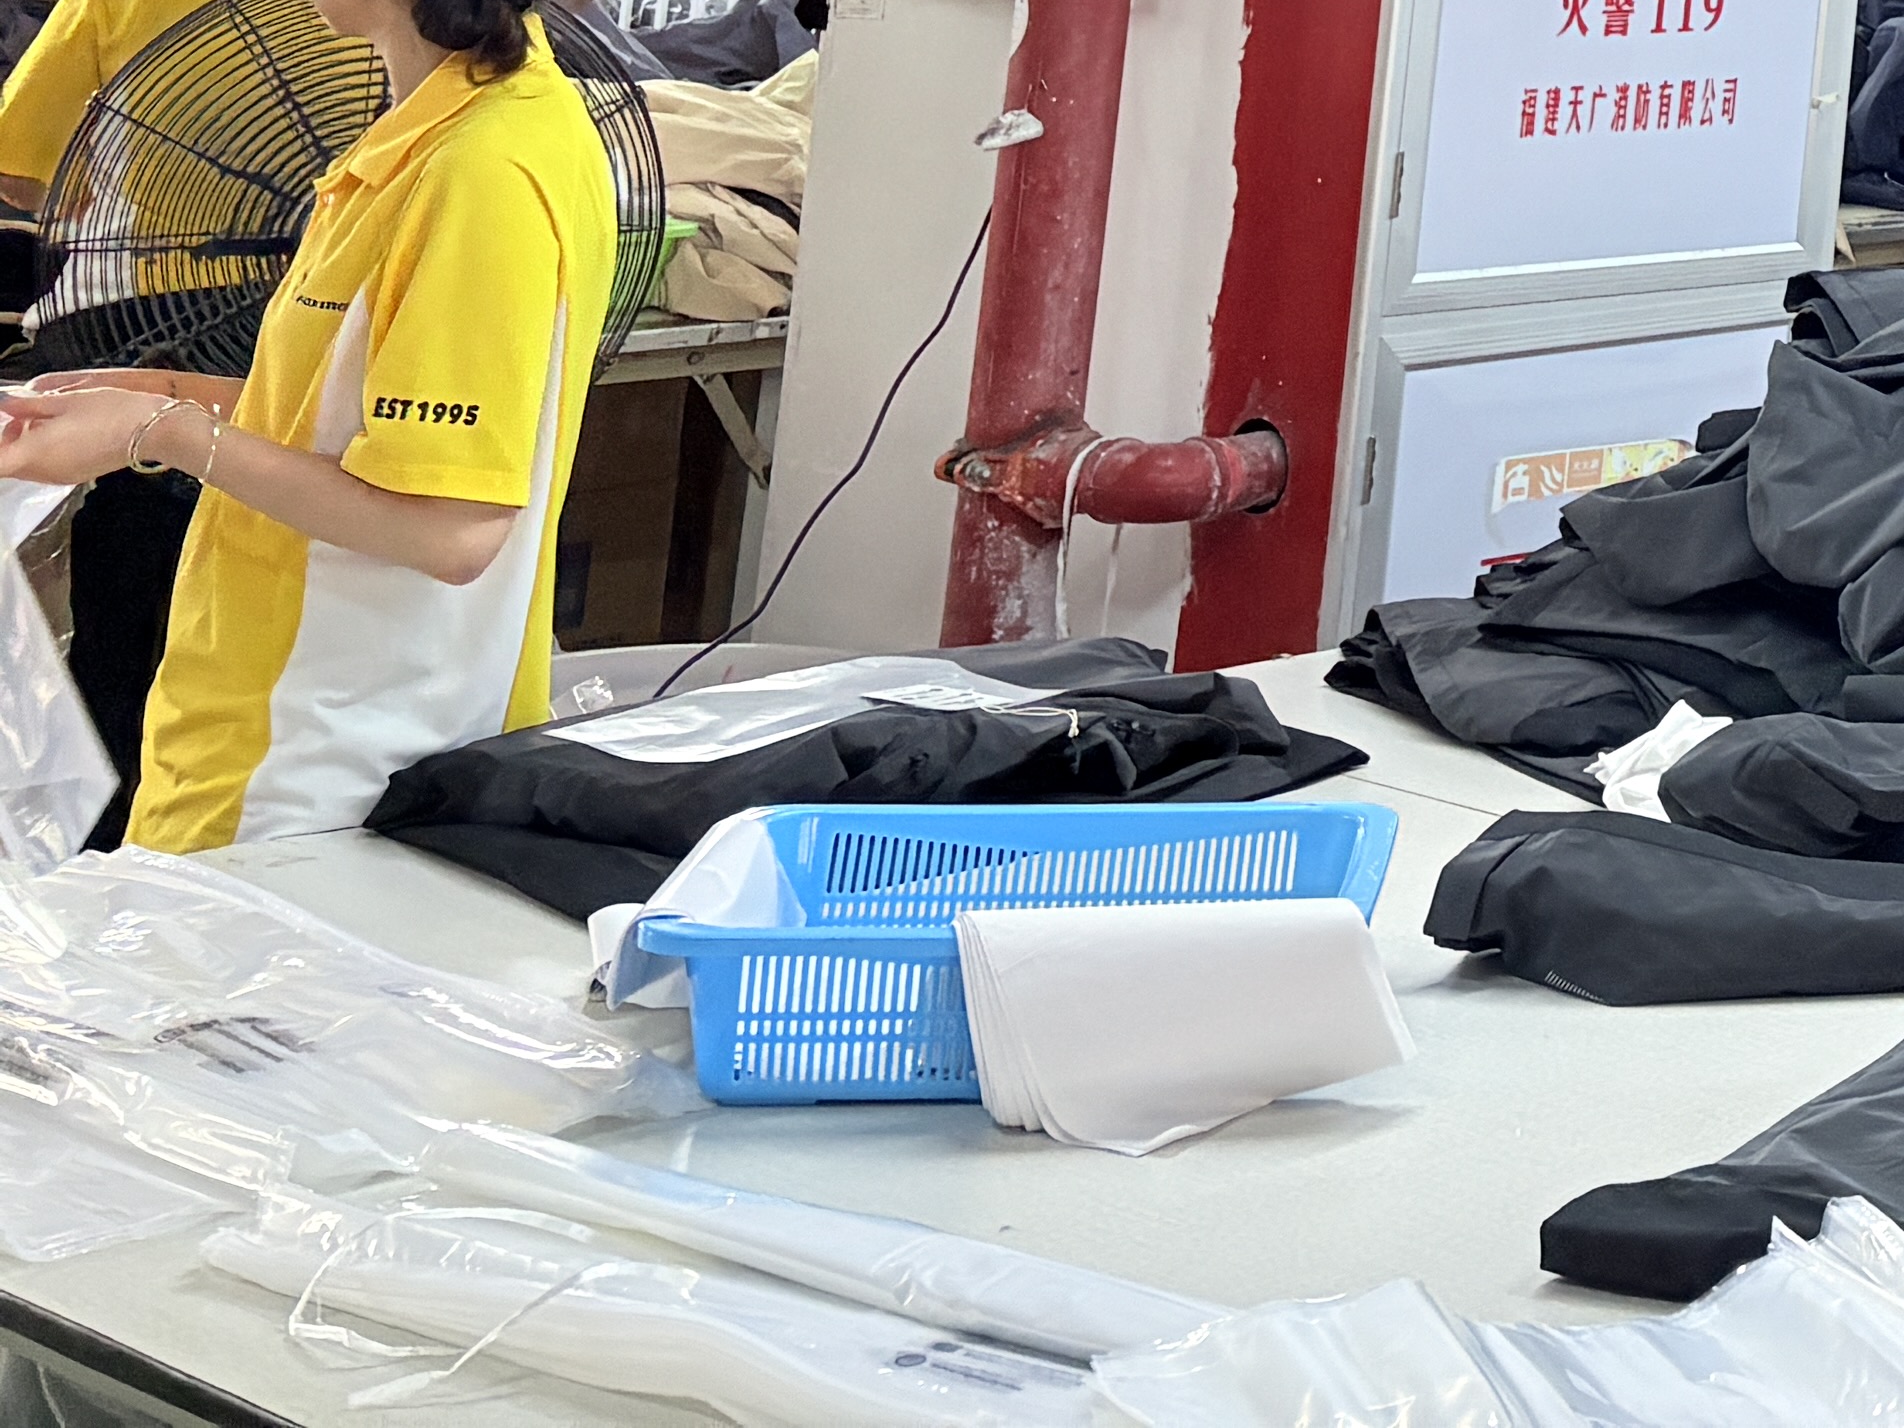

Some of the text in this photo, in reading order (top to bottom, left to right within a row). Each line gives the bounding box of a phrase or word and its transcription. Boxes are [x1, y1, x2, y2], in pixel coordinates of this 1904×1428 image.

[1519, 77, 1739, 138] 福建天广消防有限公司
[373, 397, 480, 426] EST 1995
